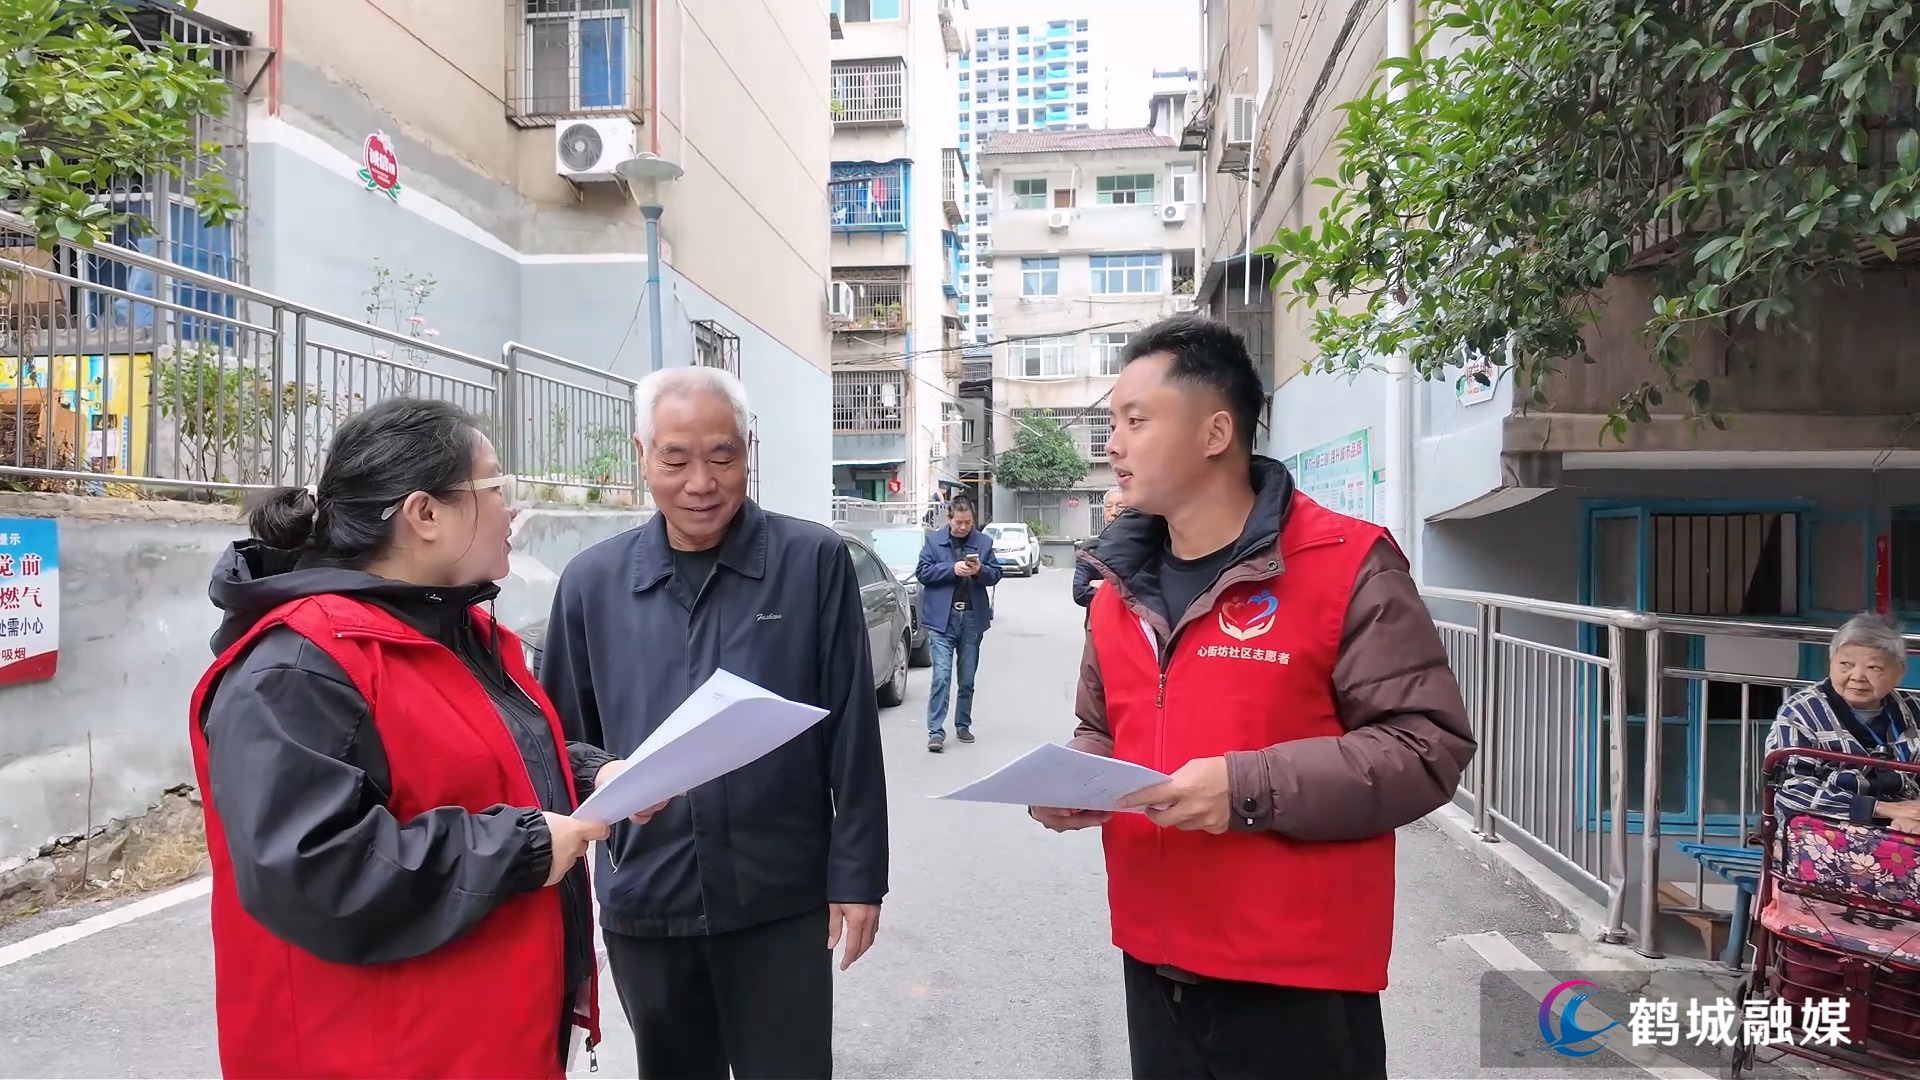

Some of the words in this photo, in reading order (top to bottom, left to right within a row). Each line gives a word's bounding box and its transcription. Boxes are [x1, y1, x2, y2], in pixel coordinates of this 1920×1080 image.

[0, 587, 43, 609] 燃气
[1197, 645, 1291, 665] 心街坊社区志愿者
